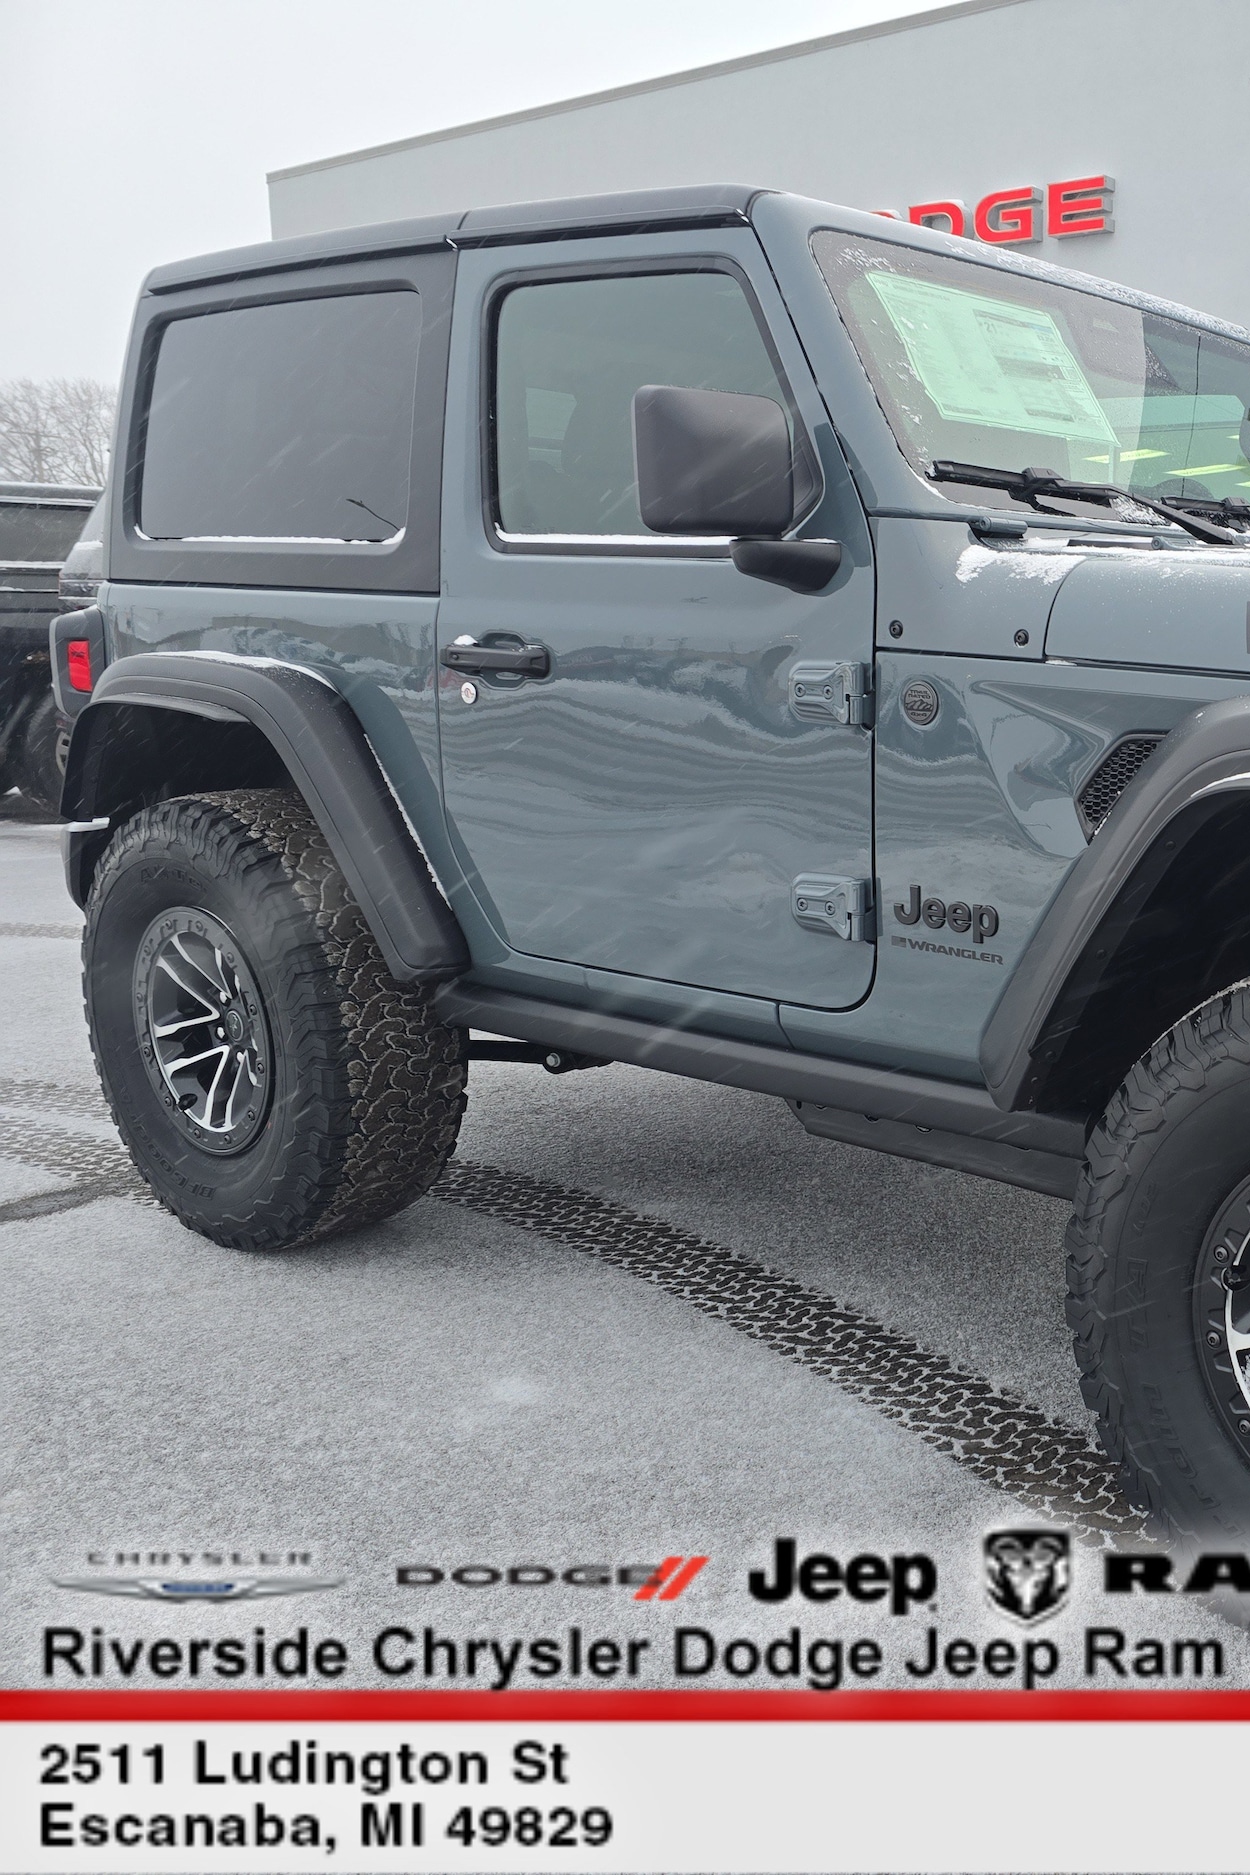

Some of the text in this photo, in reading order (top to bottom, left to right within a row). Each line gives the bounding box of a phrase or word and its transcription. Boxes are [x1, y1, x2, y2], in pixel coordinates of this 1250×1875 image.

[871, 174, 1115, 245] DGE
[893, 884, 999, 944] Jeep
[907, 938, 1004, 965] WRANGLER
